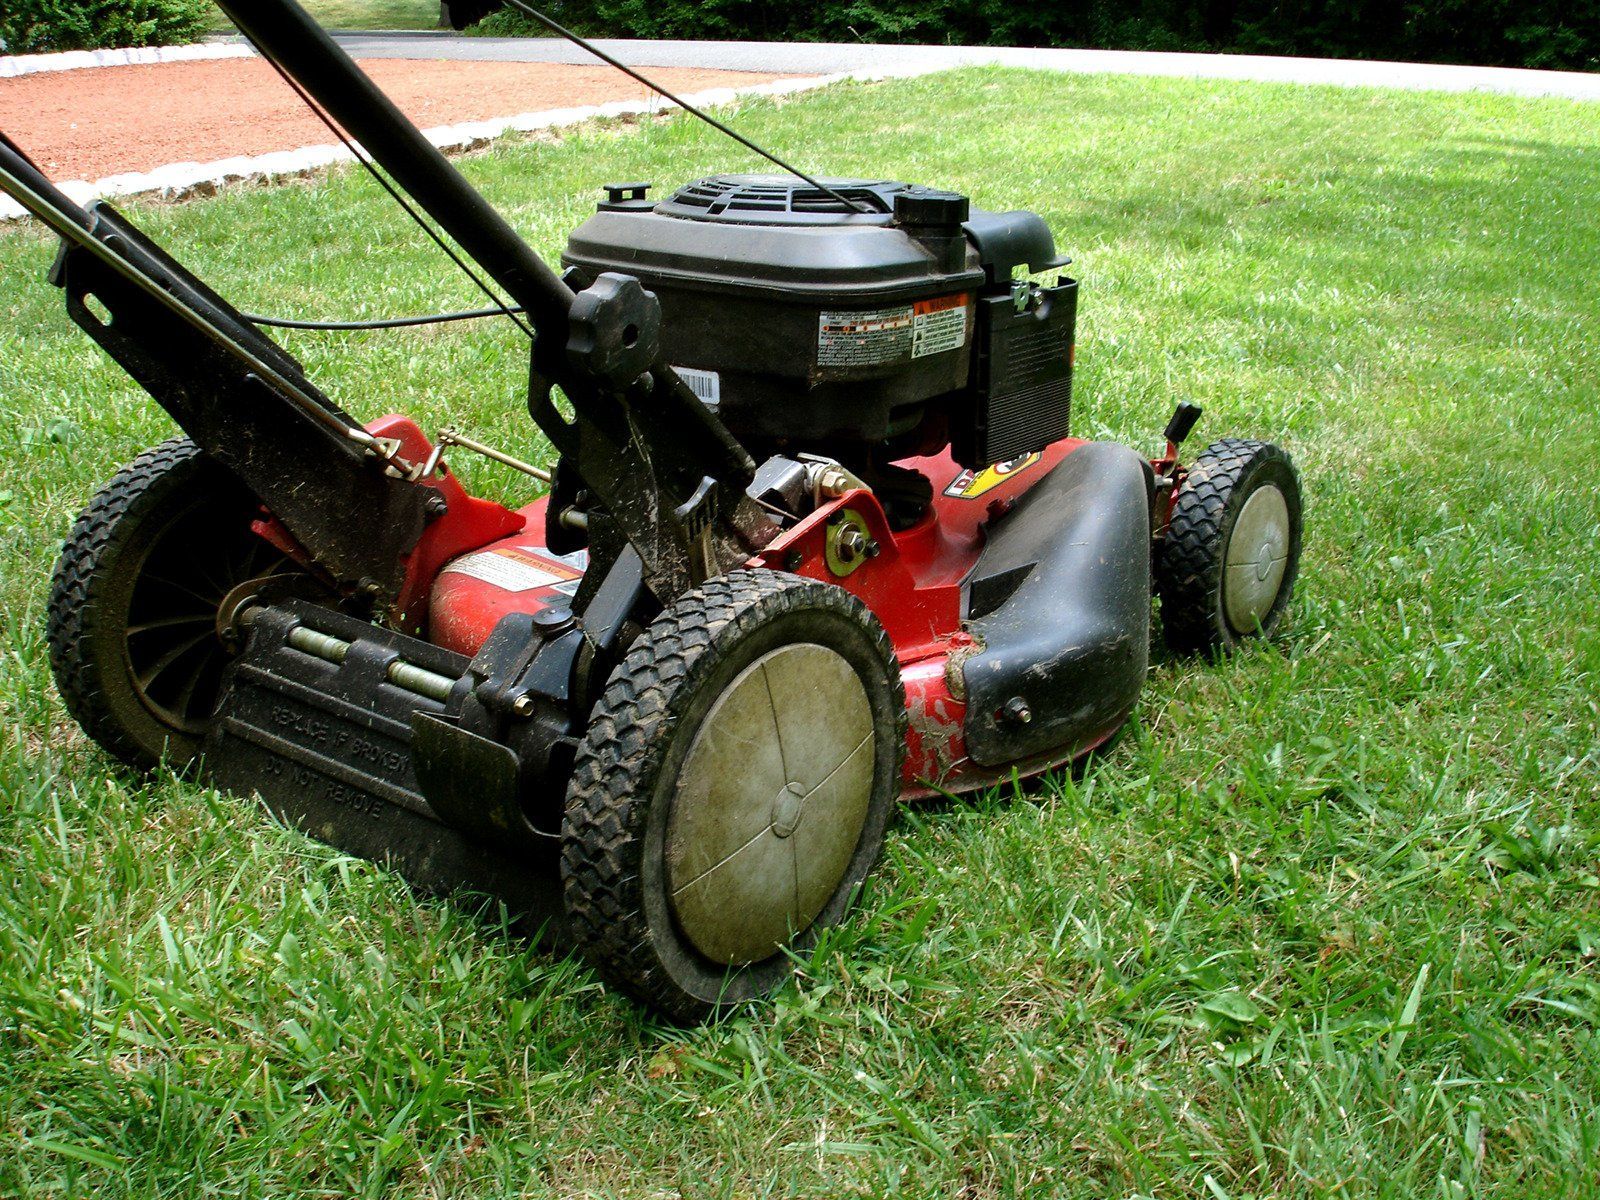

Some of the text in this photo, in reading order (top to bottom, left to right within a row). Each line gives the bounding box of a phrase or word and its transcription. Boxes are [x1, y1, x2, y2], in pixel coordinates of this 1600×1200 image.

[272, 705, 410, 775] REPLACE IF BROKEN
[265, 755, 384, 819] DO NOT REMOVE
